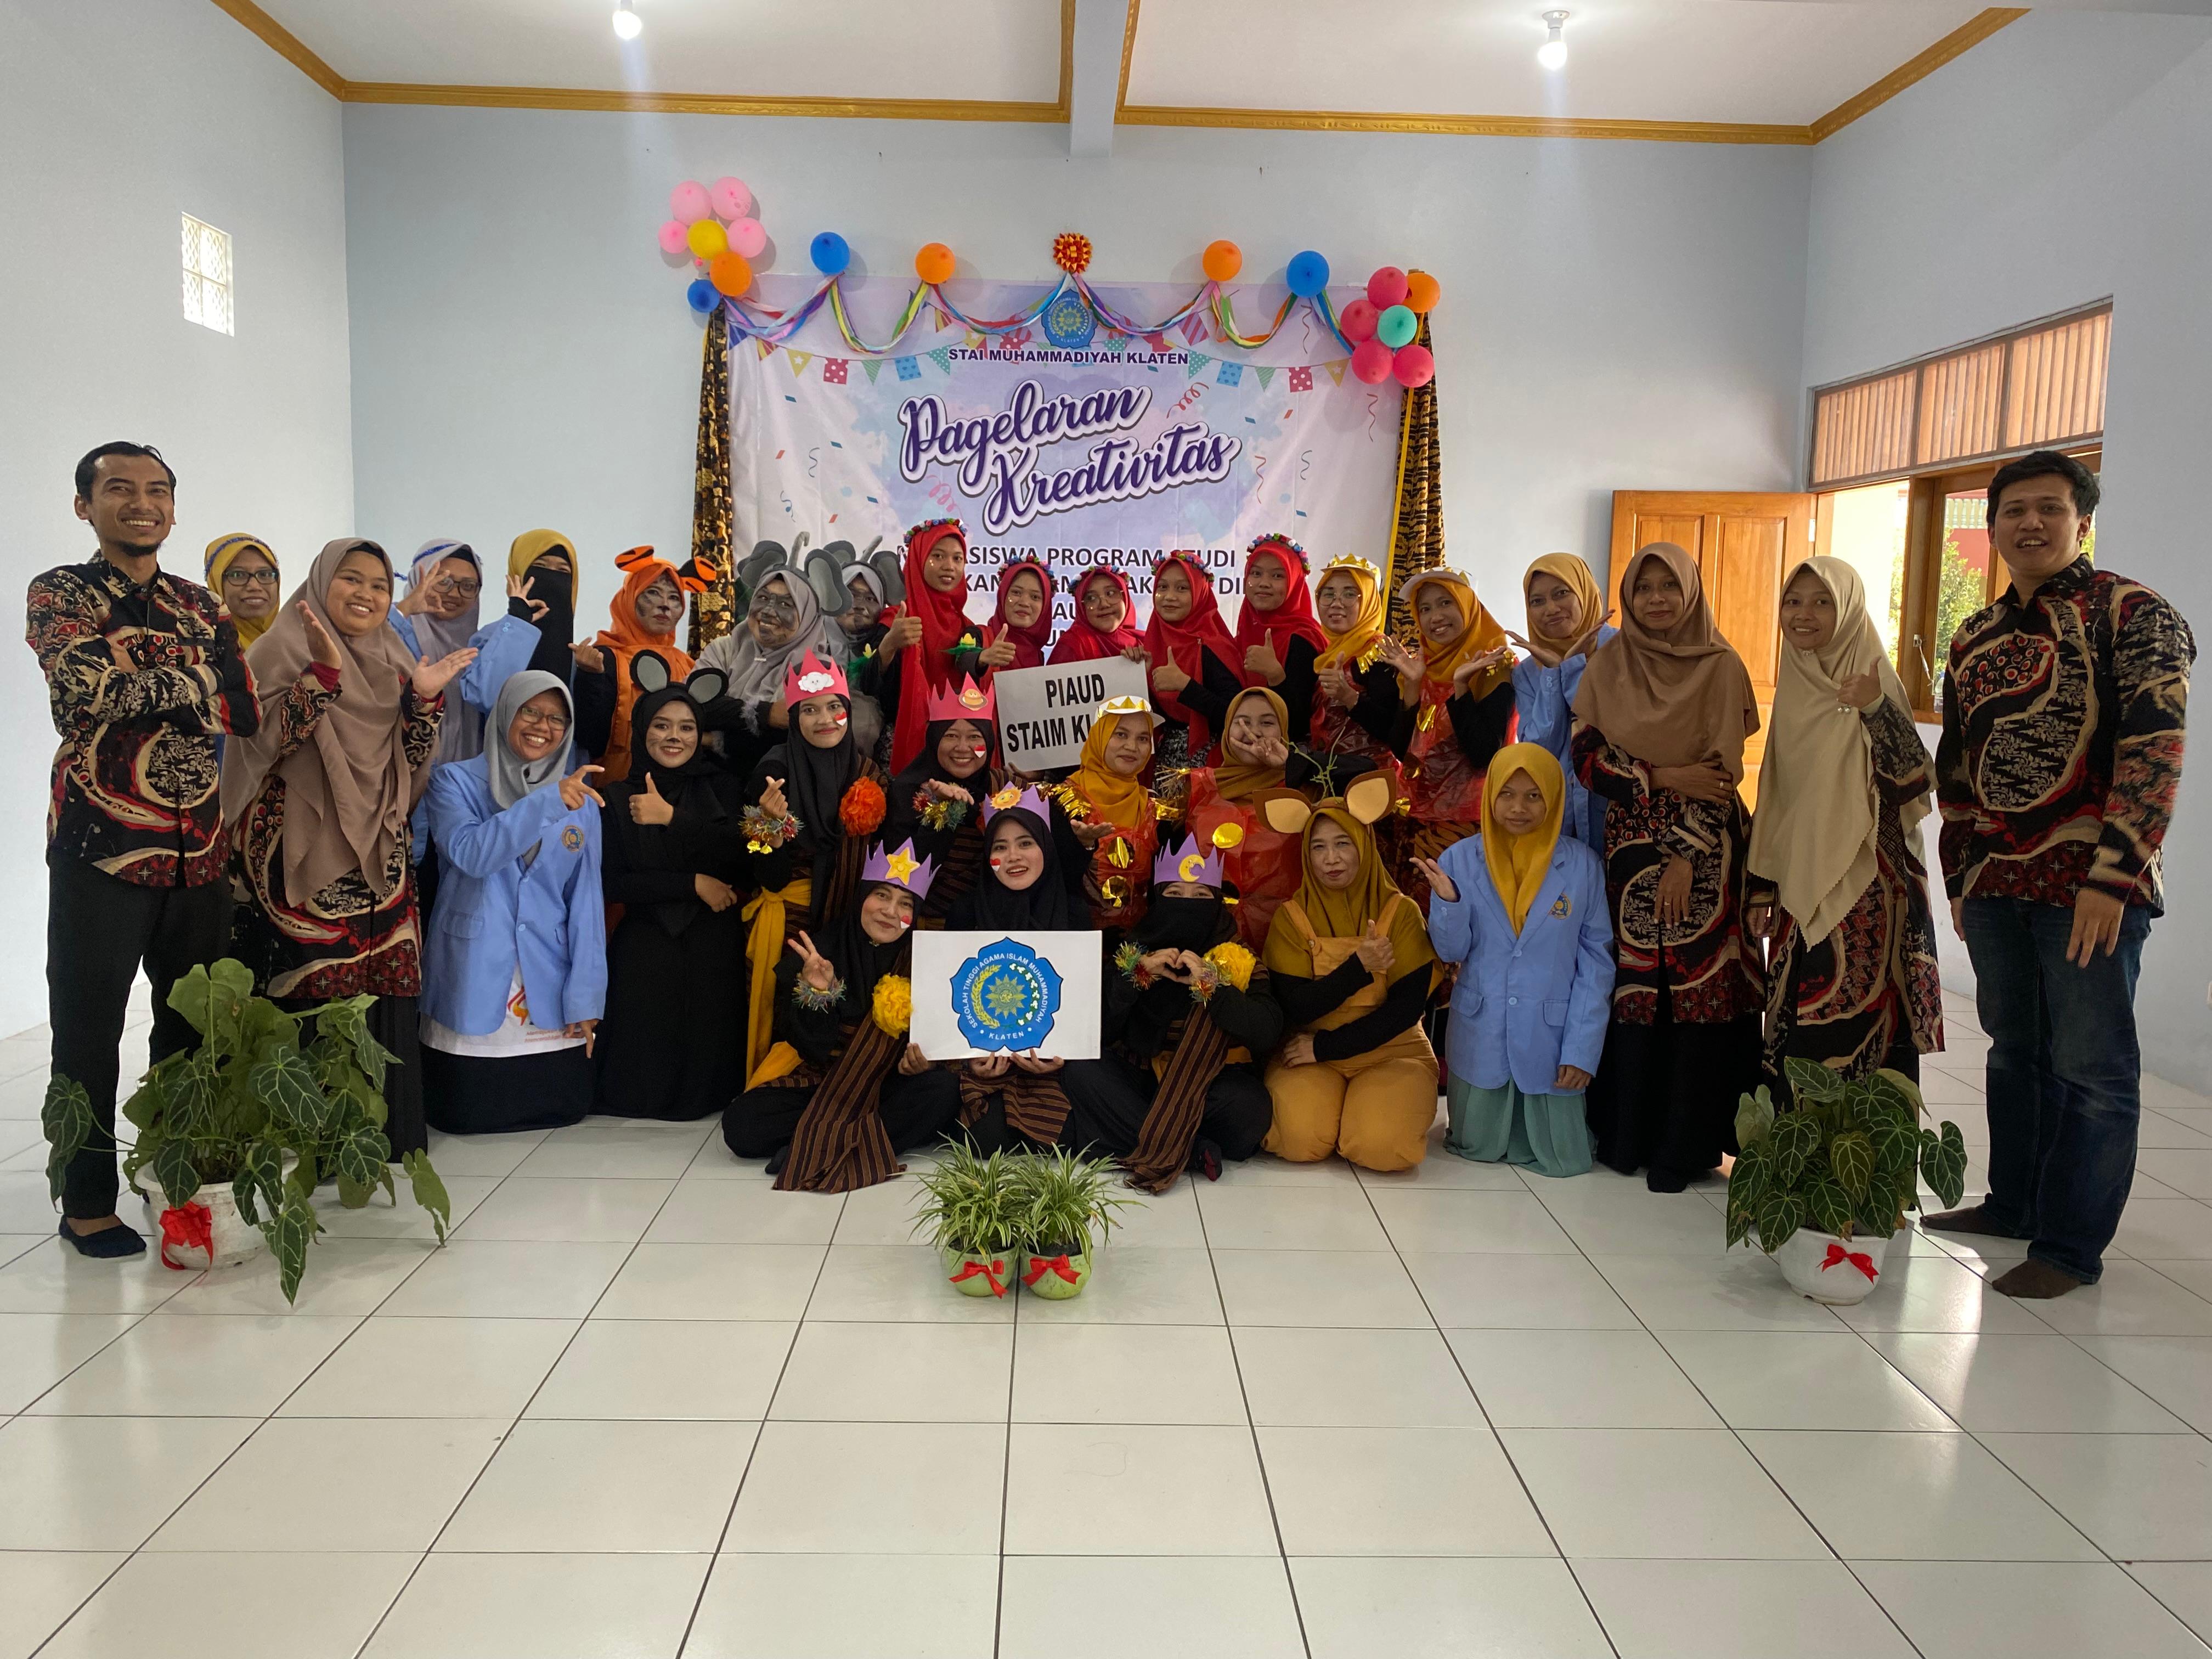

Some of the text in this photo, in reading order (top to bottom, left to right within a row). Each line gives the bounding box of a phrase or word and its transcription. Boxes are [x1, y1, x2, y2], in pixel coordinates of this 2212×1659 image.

[949, 349, 1188, 364] STAI MUHAMMADIYAH KLATEN
[902, 382, 1144, 487] Pagelaran
[988, 425, 1234, 525] Kreativitas
[1048, 548, 1163, 567] PROGRAM
[1171, 550, 1235, 567] UDI
[1045, 674, 1105, 708] PIAUD
[1007, 716, 1066, 752] STAIM
[979, 953, 1005, 968] AGAMA
[1007, 953, 1029, 966] ISLAM
[963, 966, 979, 990] TINGGI
[1029, 962, 1048, 1023] MUHAMMADIYAH
[962, 992, 978, 1028] SEKOLAH
[989, 1031, 1024, 1040] KLATEN
